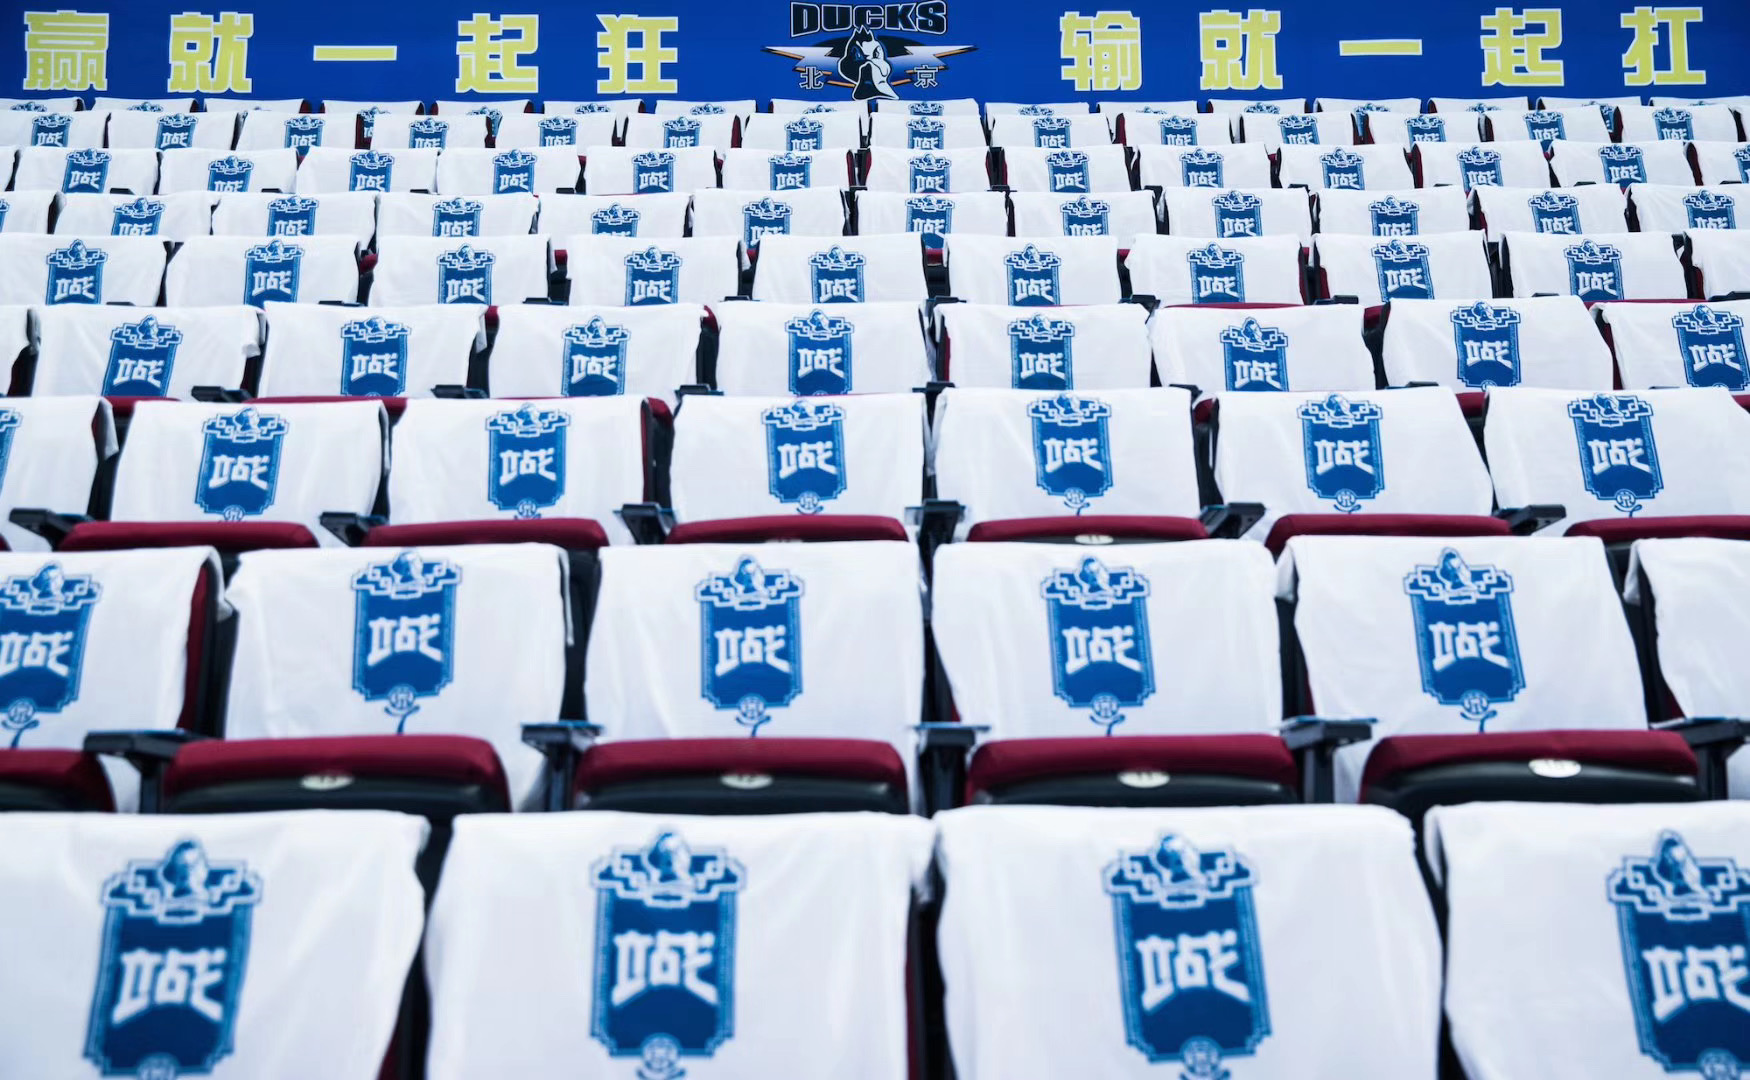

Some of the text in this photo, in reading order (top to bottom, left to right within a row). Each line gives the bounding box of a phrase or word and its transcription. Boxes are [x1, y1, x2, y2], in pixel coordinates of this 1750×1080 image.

[22, 10, 680, 94] 赢就一起狂
[789, 0, 948, 38] DUCKS
[1058, 6, 1708, 92] 输就一起扛
